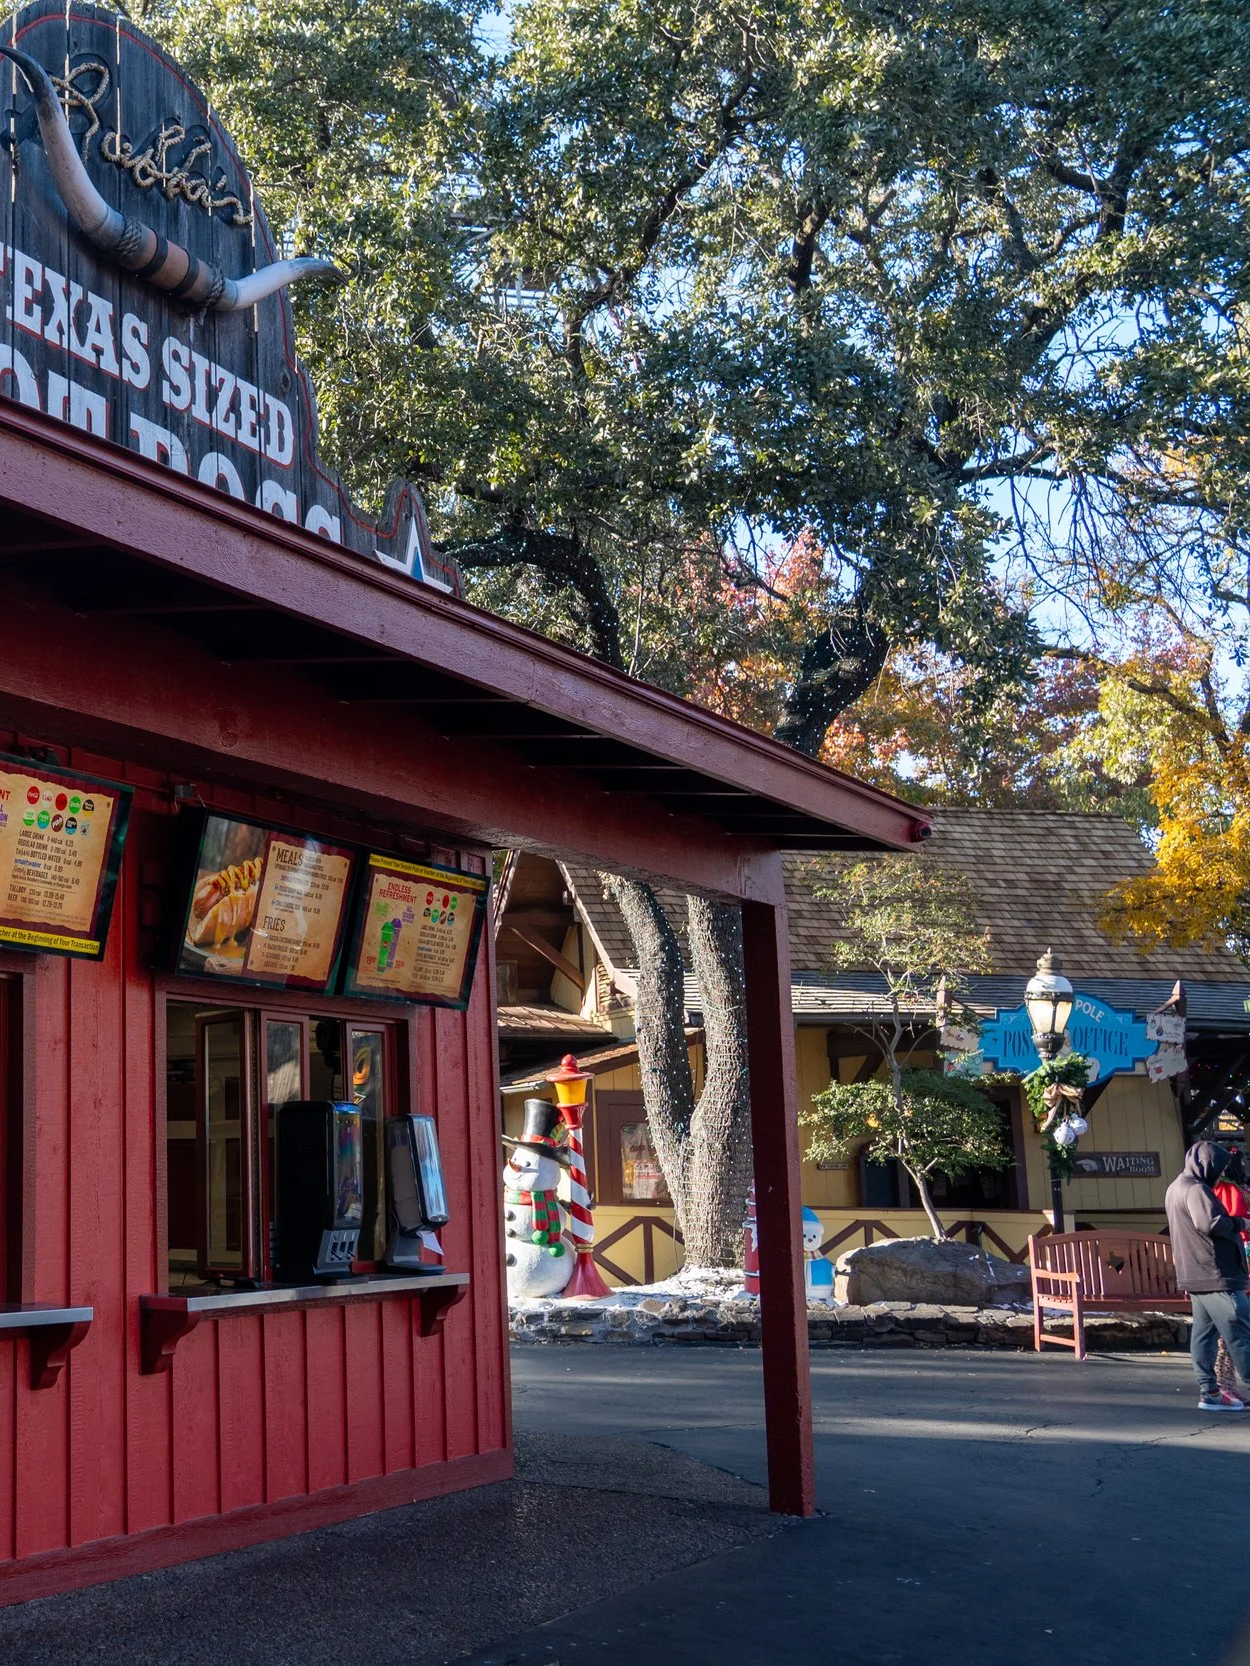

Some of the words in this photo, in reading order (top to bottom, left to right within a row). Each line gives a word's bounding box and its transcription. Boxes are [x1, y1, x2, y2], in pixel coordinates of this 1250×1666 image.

[162, 336, 294, 466] SIZED
[275, 848, 304, 867] MEALS
[378, 889, 417, 904] REFRESHMENT
[387, 882, 412, 894] ENDLESS
[262, 915, 286, 932] FRIES
[11, 930, 18, 939] at
[18, 931, 27, 940] the
[27, 933, 53, 946] Beginning
[53, 936, 59, 944] of
[59, 937, 71, 947] Your
[71, 940, 99, 951] Transaction
[1075, 999, 1105, 1023] POLE
[1073, 1026, 1129, 1057] OFFICE
[1102, 1156, 1155, 1173] WAITING
[1130, 1165, 1155, 1173] ROOM
